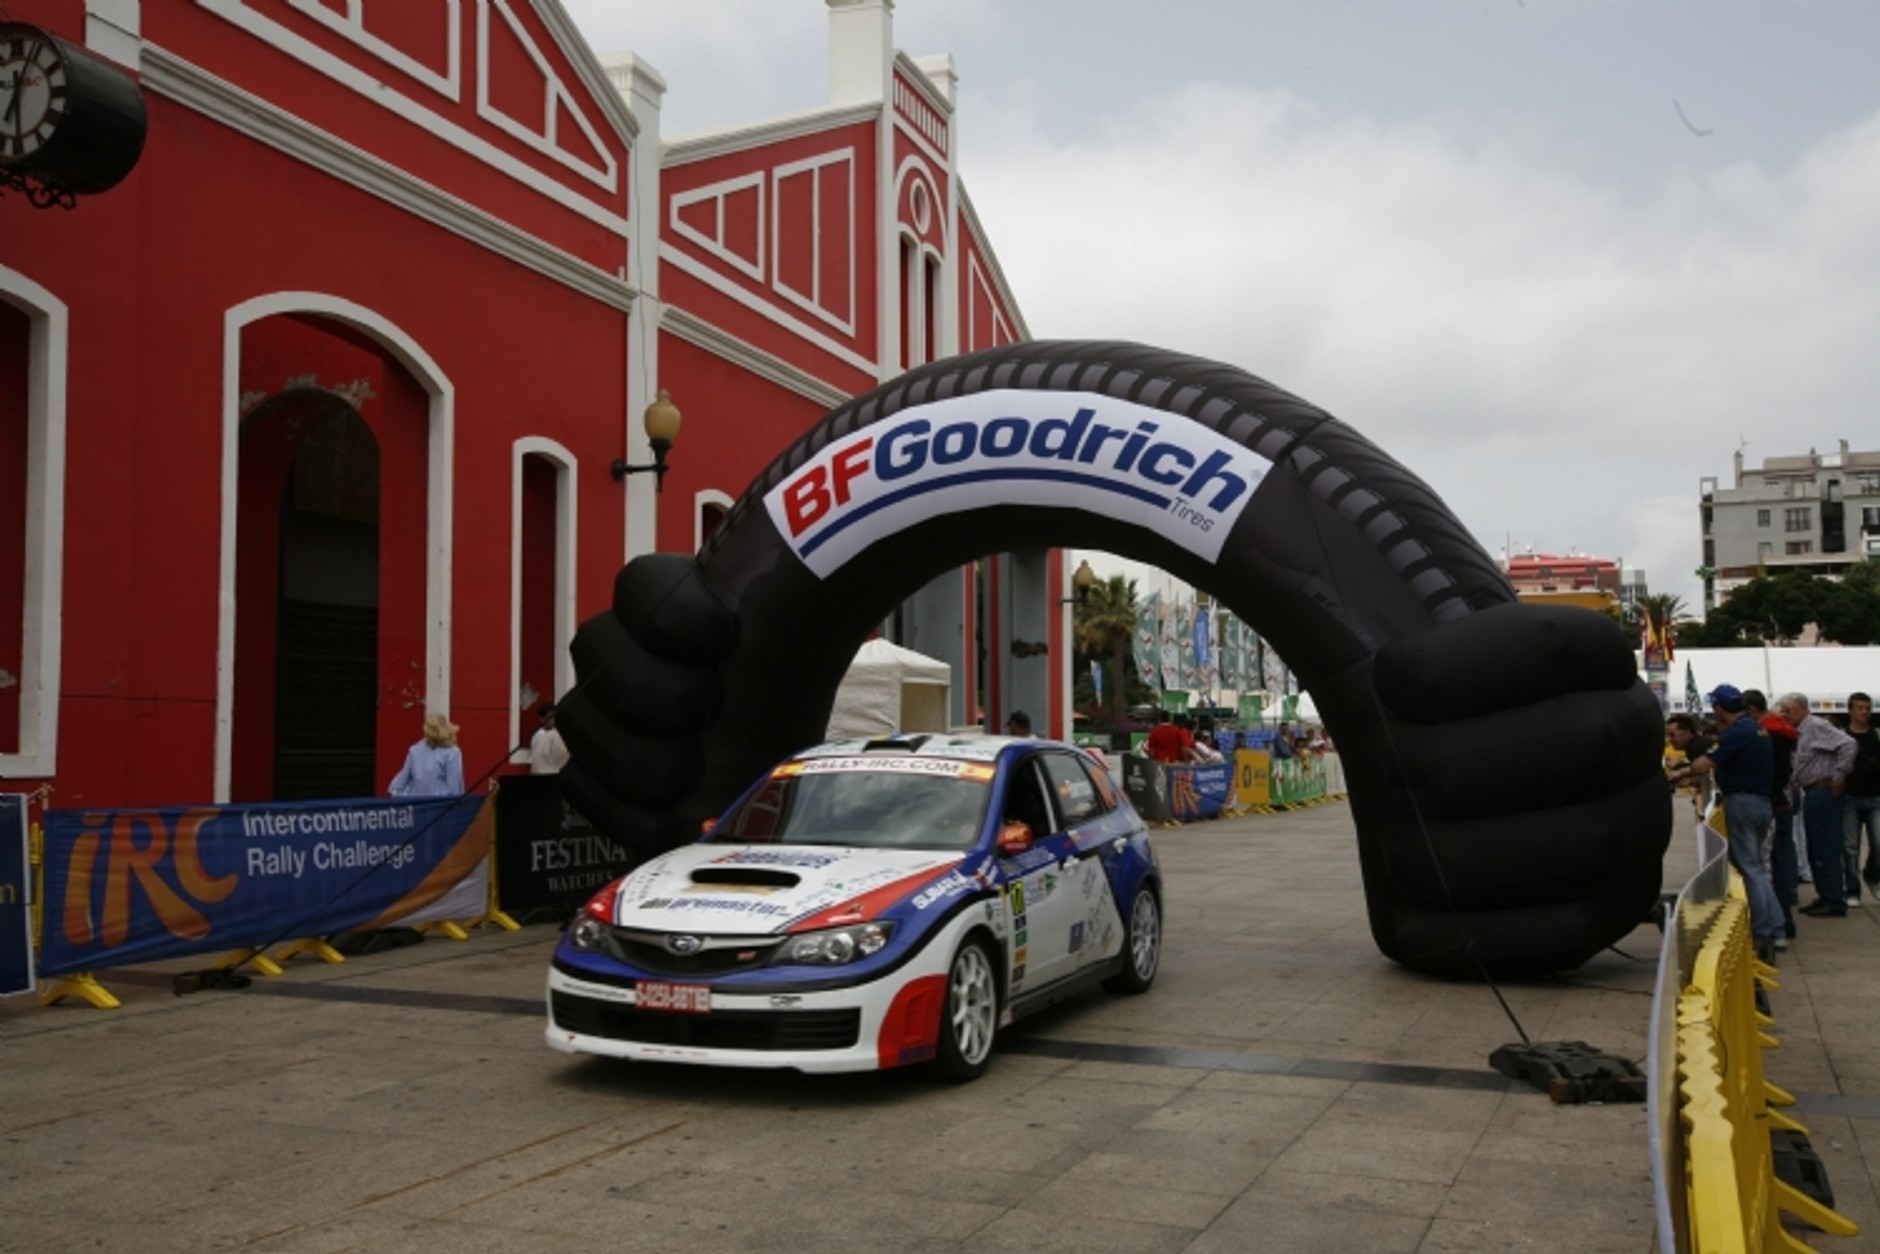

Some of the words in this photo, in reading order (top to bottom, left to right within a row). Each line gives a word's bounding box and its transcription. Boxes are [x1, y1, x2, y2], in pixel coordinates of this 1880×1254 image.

[782, 408, 1247, 538] BFGoodrich
[1170, 496, 1215, 532] Tires
[242, 805, 416, 837] Intercontinental
[247, 844, 306, 878] Rally
[313, 840, 415, 870] Challenge
[530, 835, 627, 871] FESTINA
[548, 869, 614, 892] WATCHES
